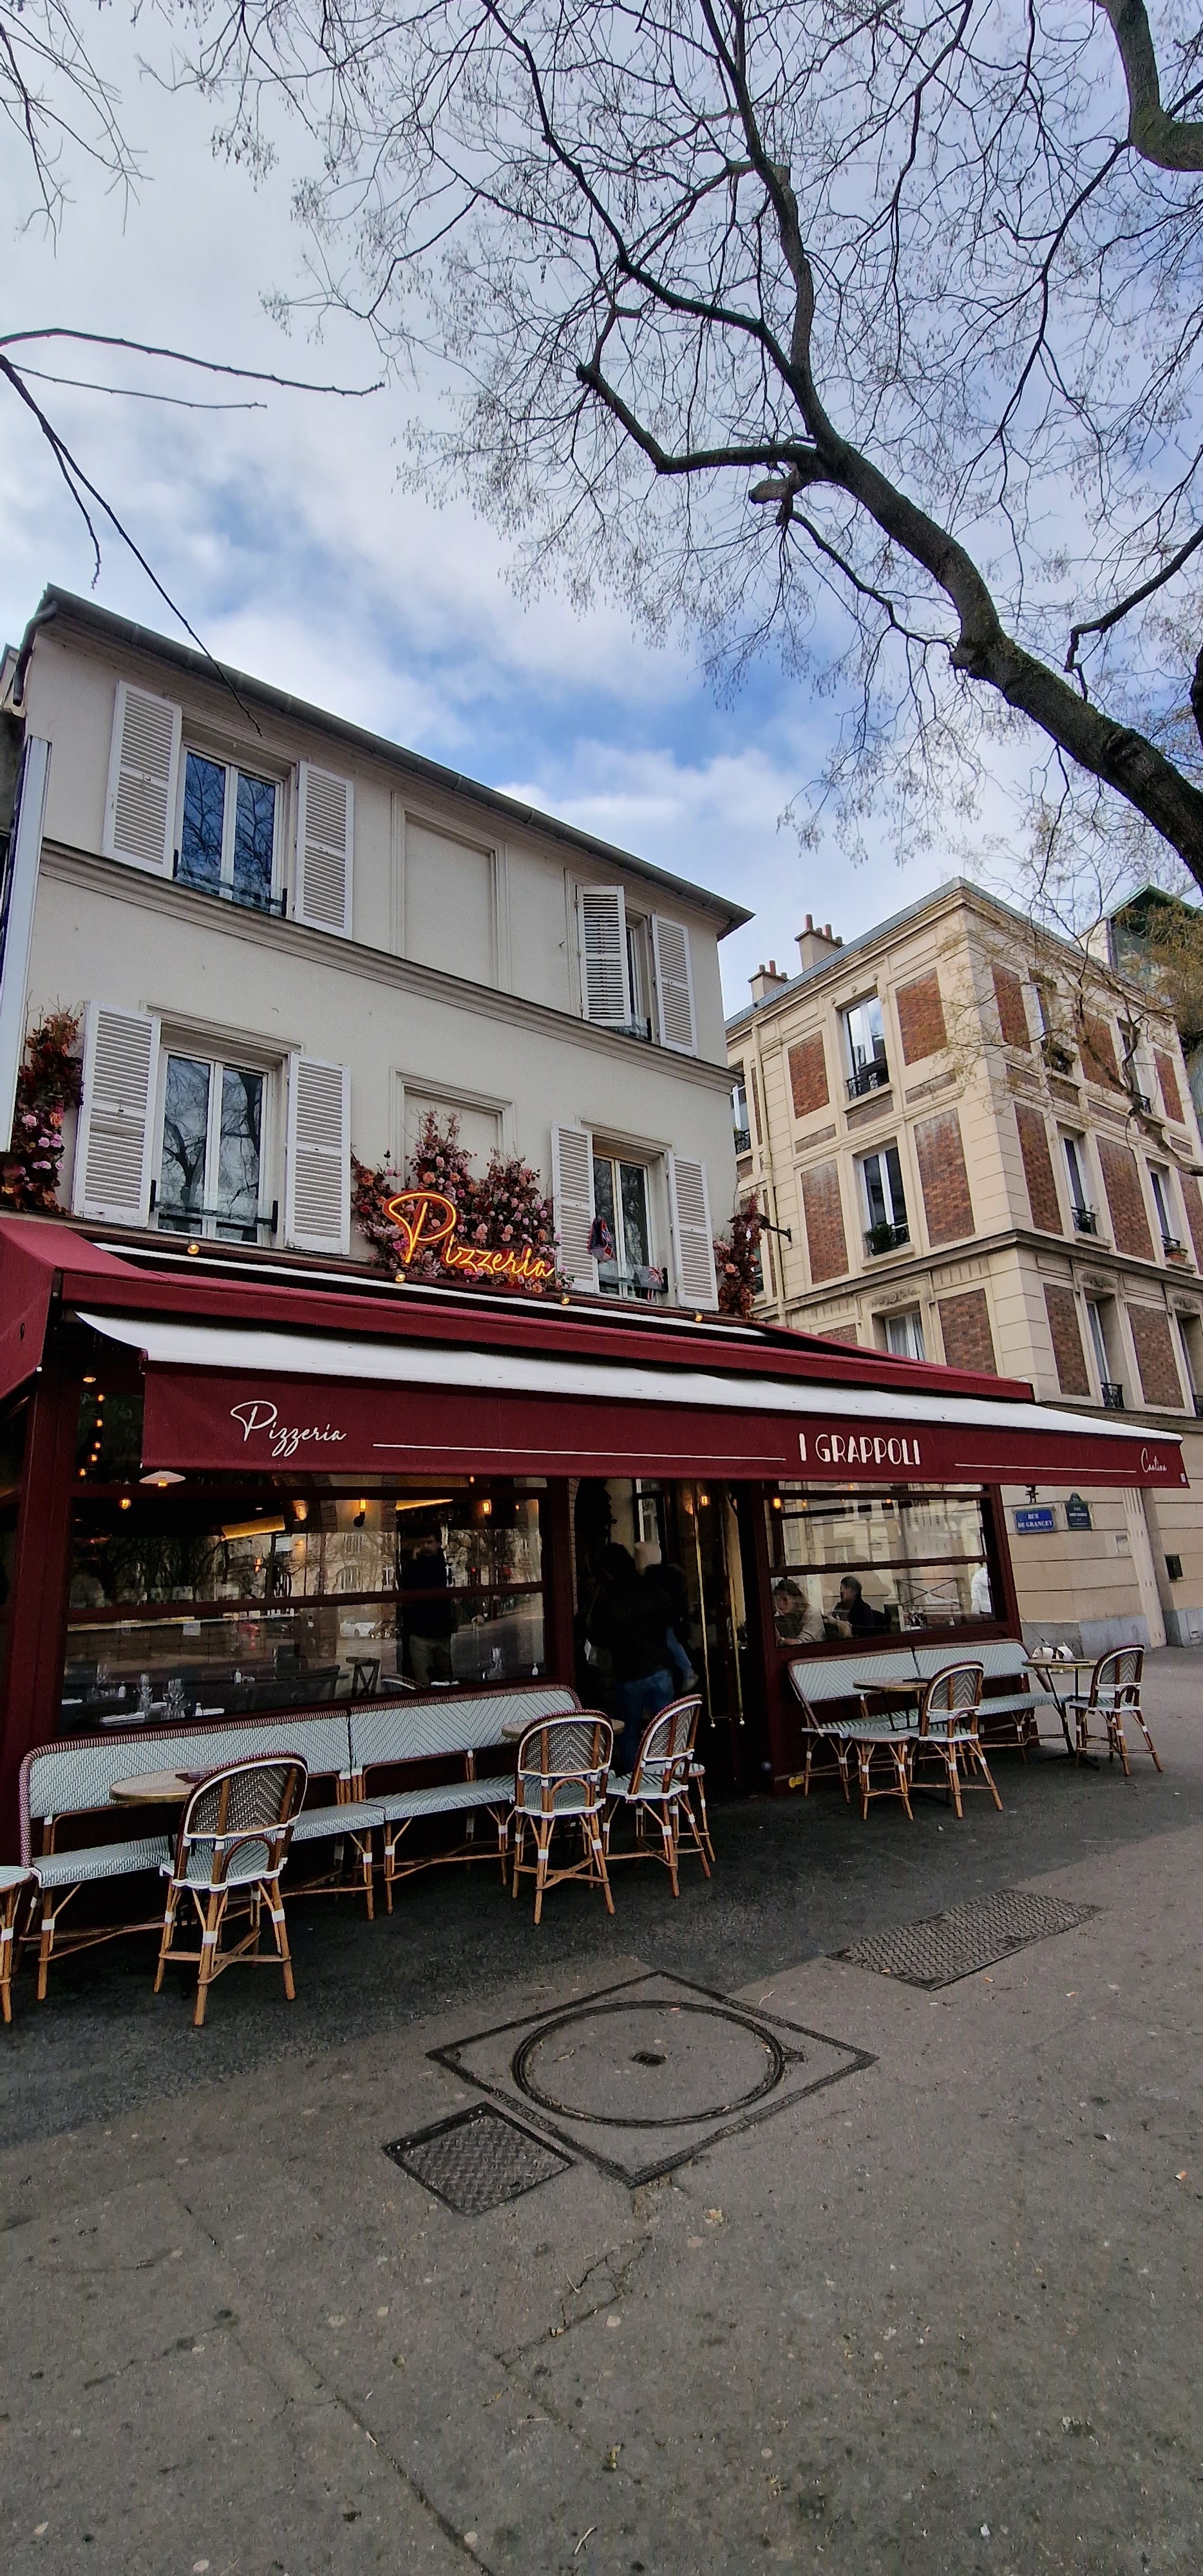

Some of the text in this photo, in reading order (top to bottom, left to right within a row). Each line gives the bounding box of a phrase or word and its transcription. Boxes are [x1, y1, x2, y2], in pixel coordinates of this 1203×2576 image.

[384, 1191, 556, 1278] Pizzeria
[230, 1400, 347, 1457] Pizzeria
[799, 1433, 920, 1465] I GRAPPOLI
